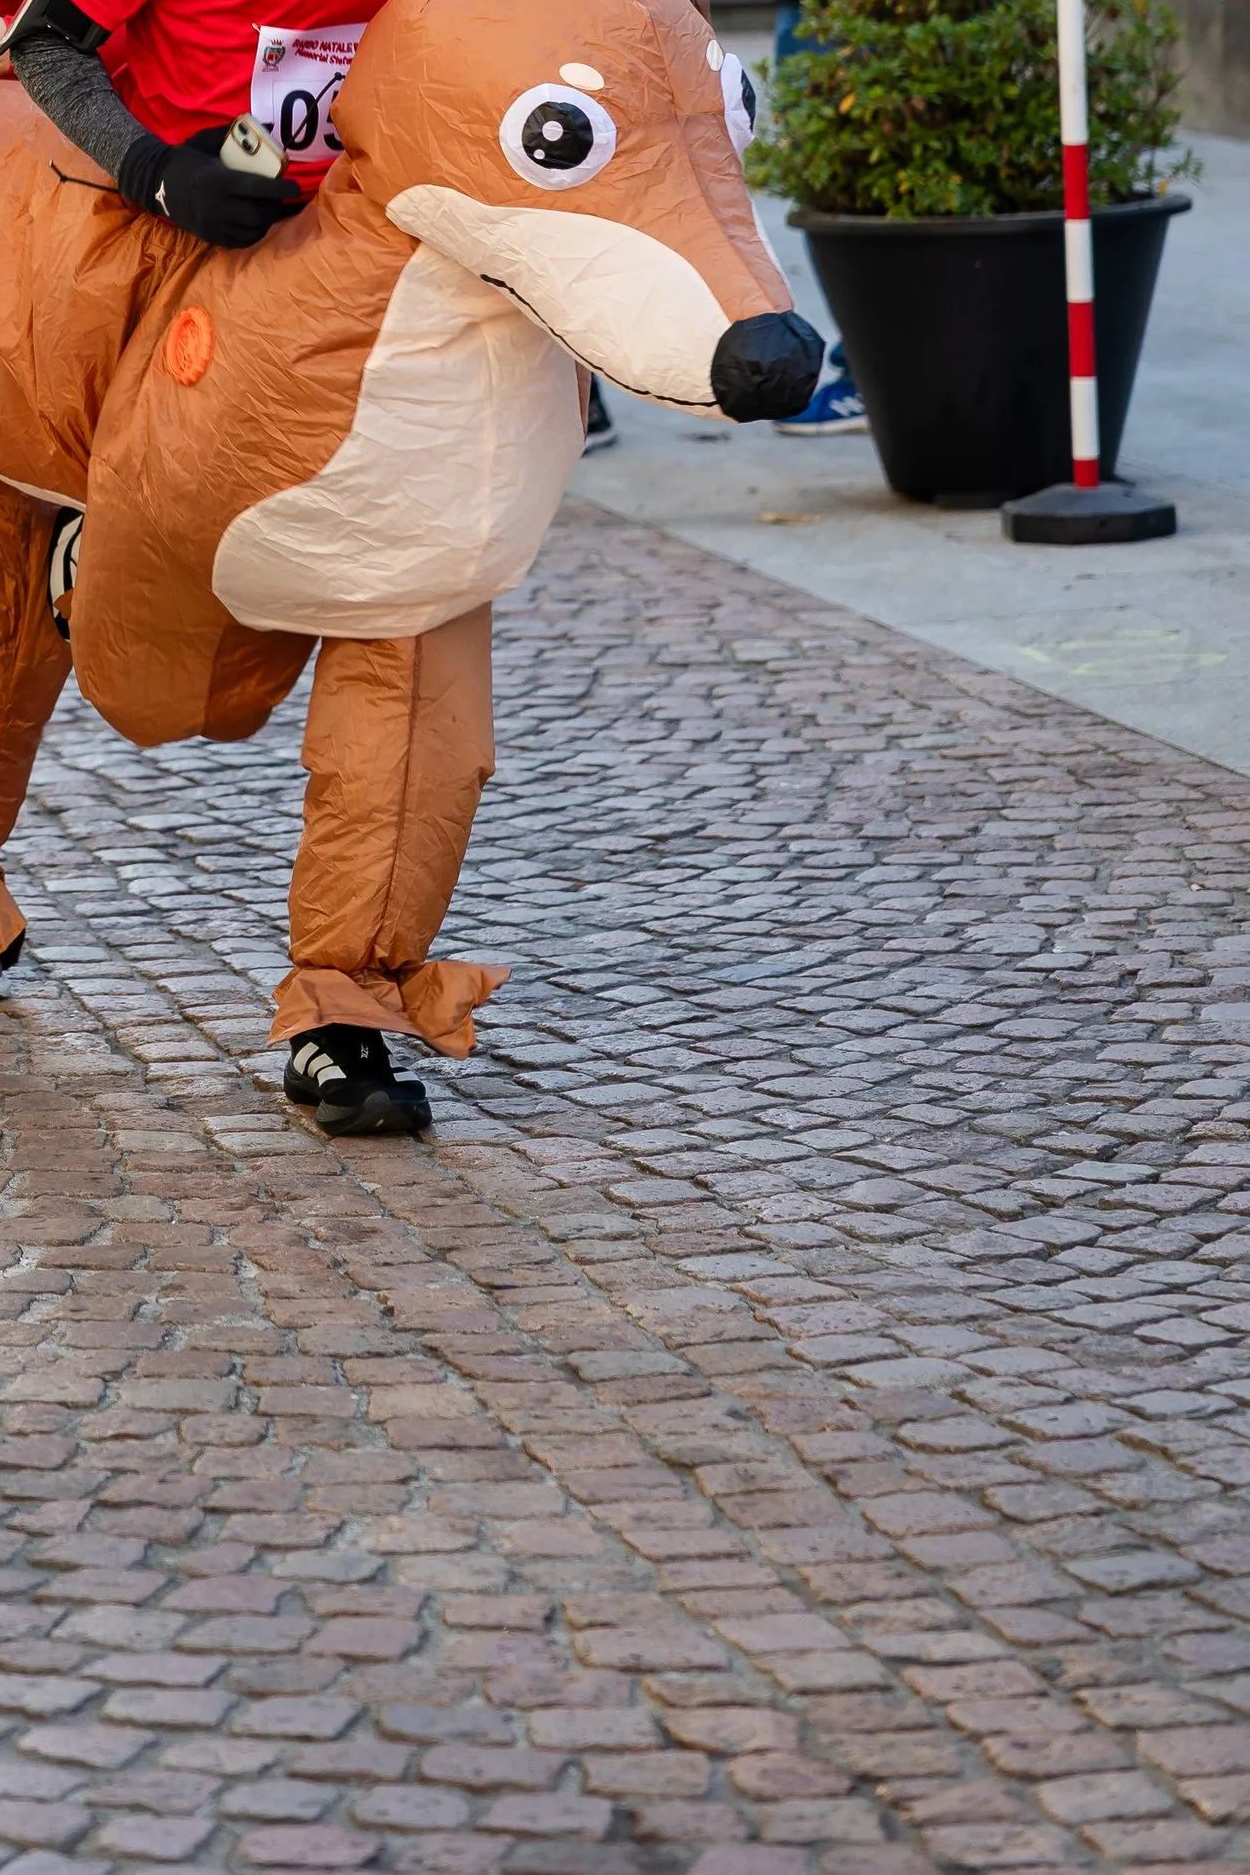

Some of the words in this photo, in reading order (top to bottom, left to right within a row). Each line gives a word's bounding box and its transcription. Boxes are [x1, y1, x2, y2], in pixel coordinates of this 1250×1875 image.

[293, 38, 319, 51] BABBO
[320, 41, 352, 53] NATALE
[295, 48, 329, 62] Memorial
